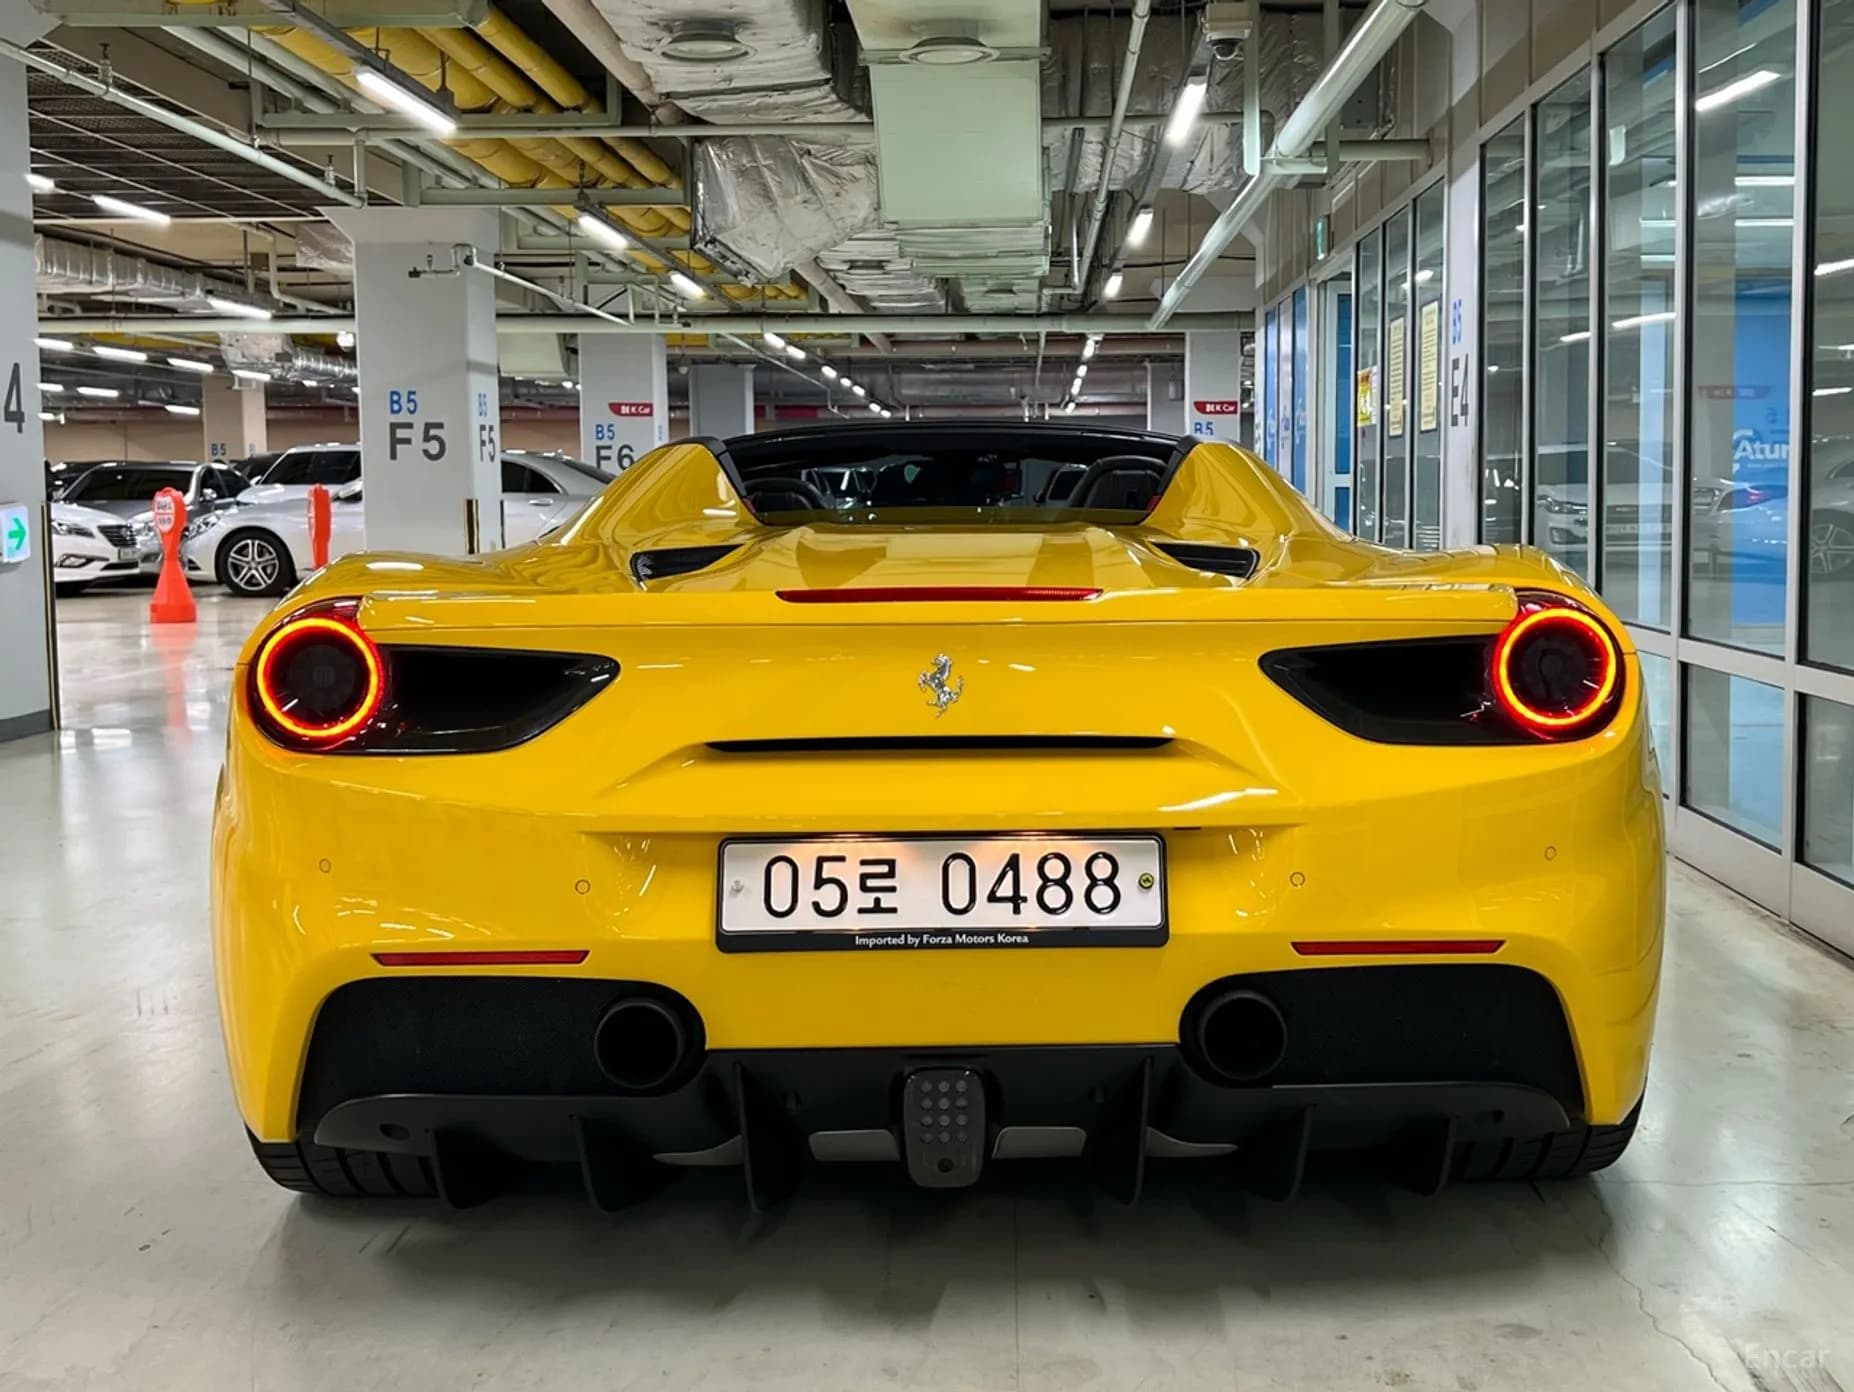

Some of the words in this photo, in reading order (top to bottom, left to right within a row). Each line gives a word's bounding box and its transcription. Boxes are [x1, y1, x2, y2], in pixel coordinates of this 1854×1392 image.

[4, 362, 25, 434] 4
[389, 390, 418, 415] B5
[1451, 353, 1469, 427] E4
[389, 422, 447, 461] F5
[479, 424, 496, 463] F5
[595, 423, 616, 441] B5
[211, 443, 227, 457] B5
[596, 444, 634, 471] F6
[763, 854, 899, 919] 05로
[941, 851, 1122, 916] 0488
[855, 934, 905, 948] Imported
[907, 934, 920, 948] by
[922, 933, 952, 945] Forza
[955, 933, 995, 944] Motors
[997, 932, 1030, 944] Korea
